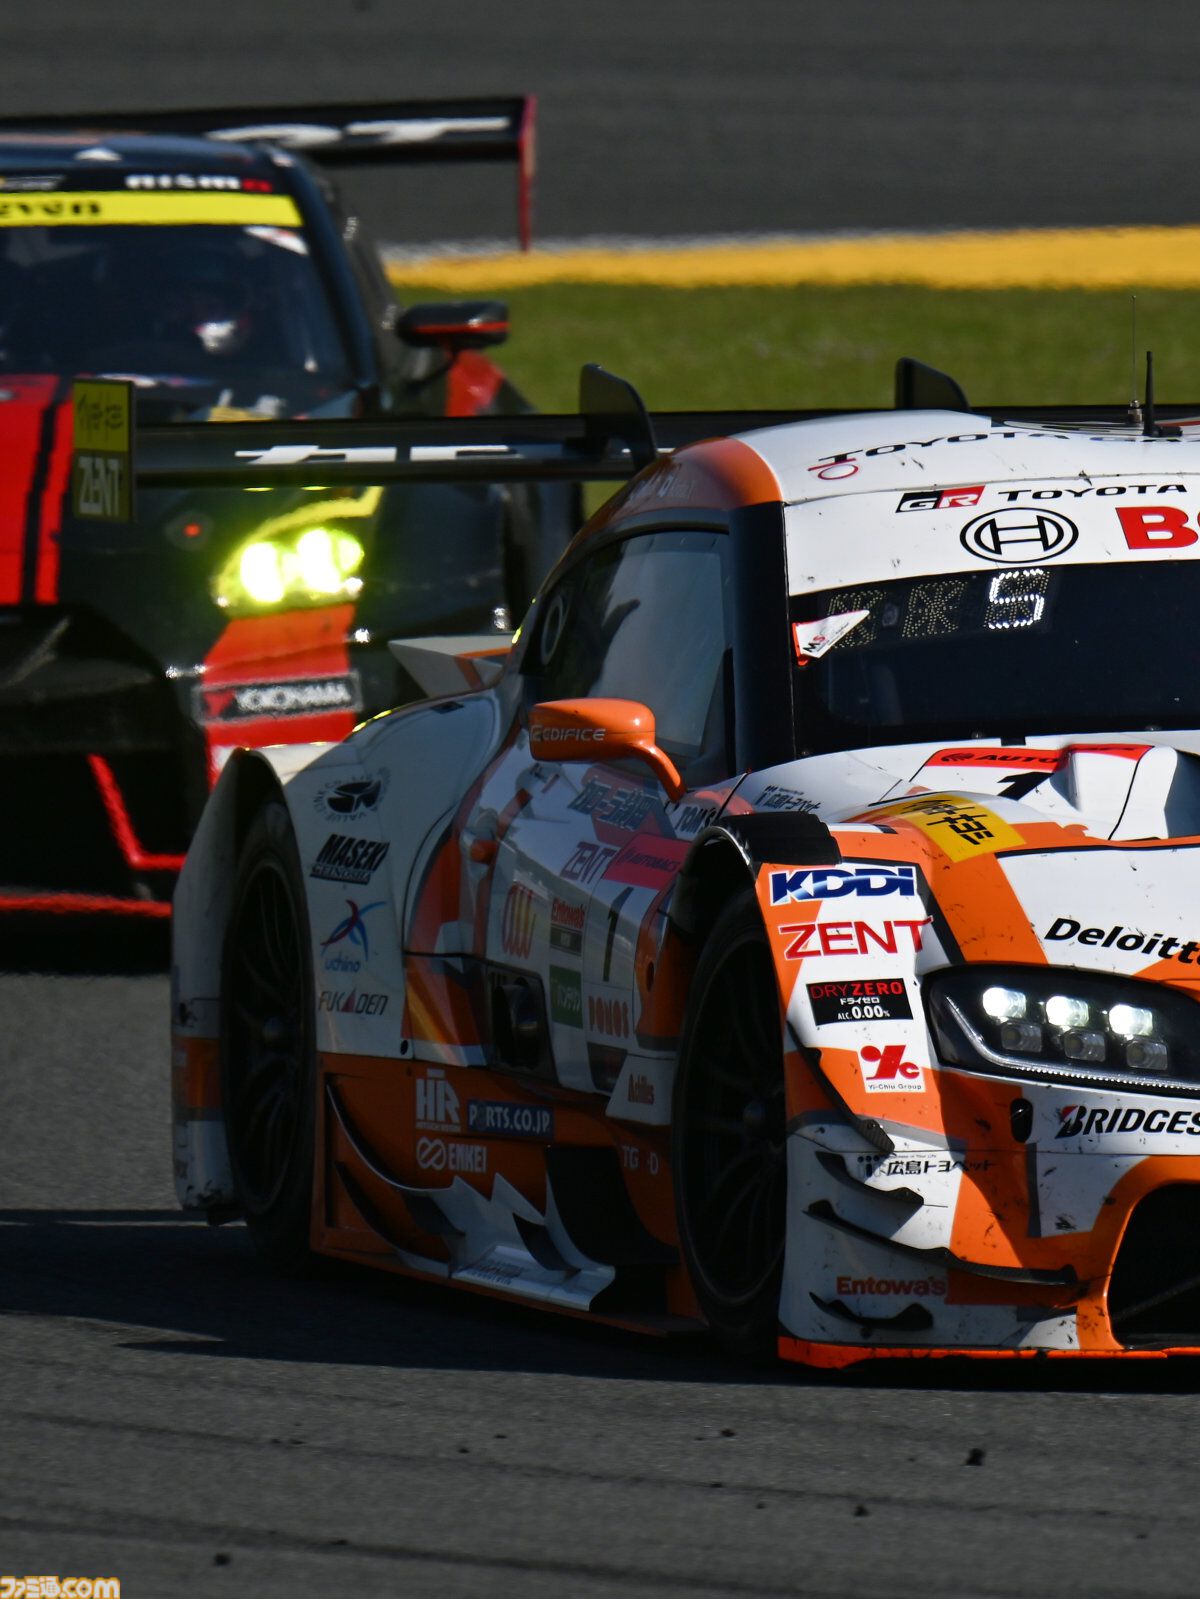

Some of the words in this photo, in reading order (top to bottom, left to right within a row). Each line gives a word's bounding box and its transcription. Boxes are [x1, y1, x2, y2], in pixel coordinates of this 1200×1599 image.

[899, 491, 980, 512] GR
[998, 484, 1187, 502] TOYOTA
[316, 833, 391, 873] MASEKI
[559, 841, 619, 885] ZENT
[771, 866, 915, 905] KDDI
[778, 915, 934, 960] ZENT
[839, 996, 881, 1006] ドライゼロ
[897, 1083, 923, 1093] Group
[448, 1142, 488, 1174] ENKEI
[836, 1275, 947, 1297] Entowa's
